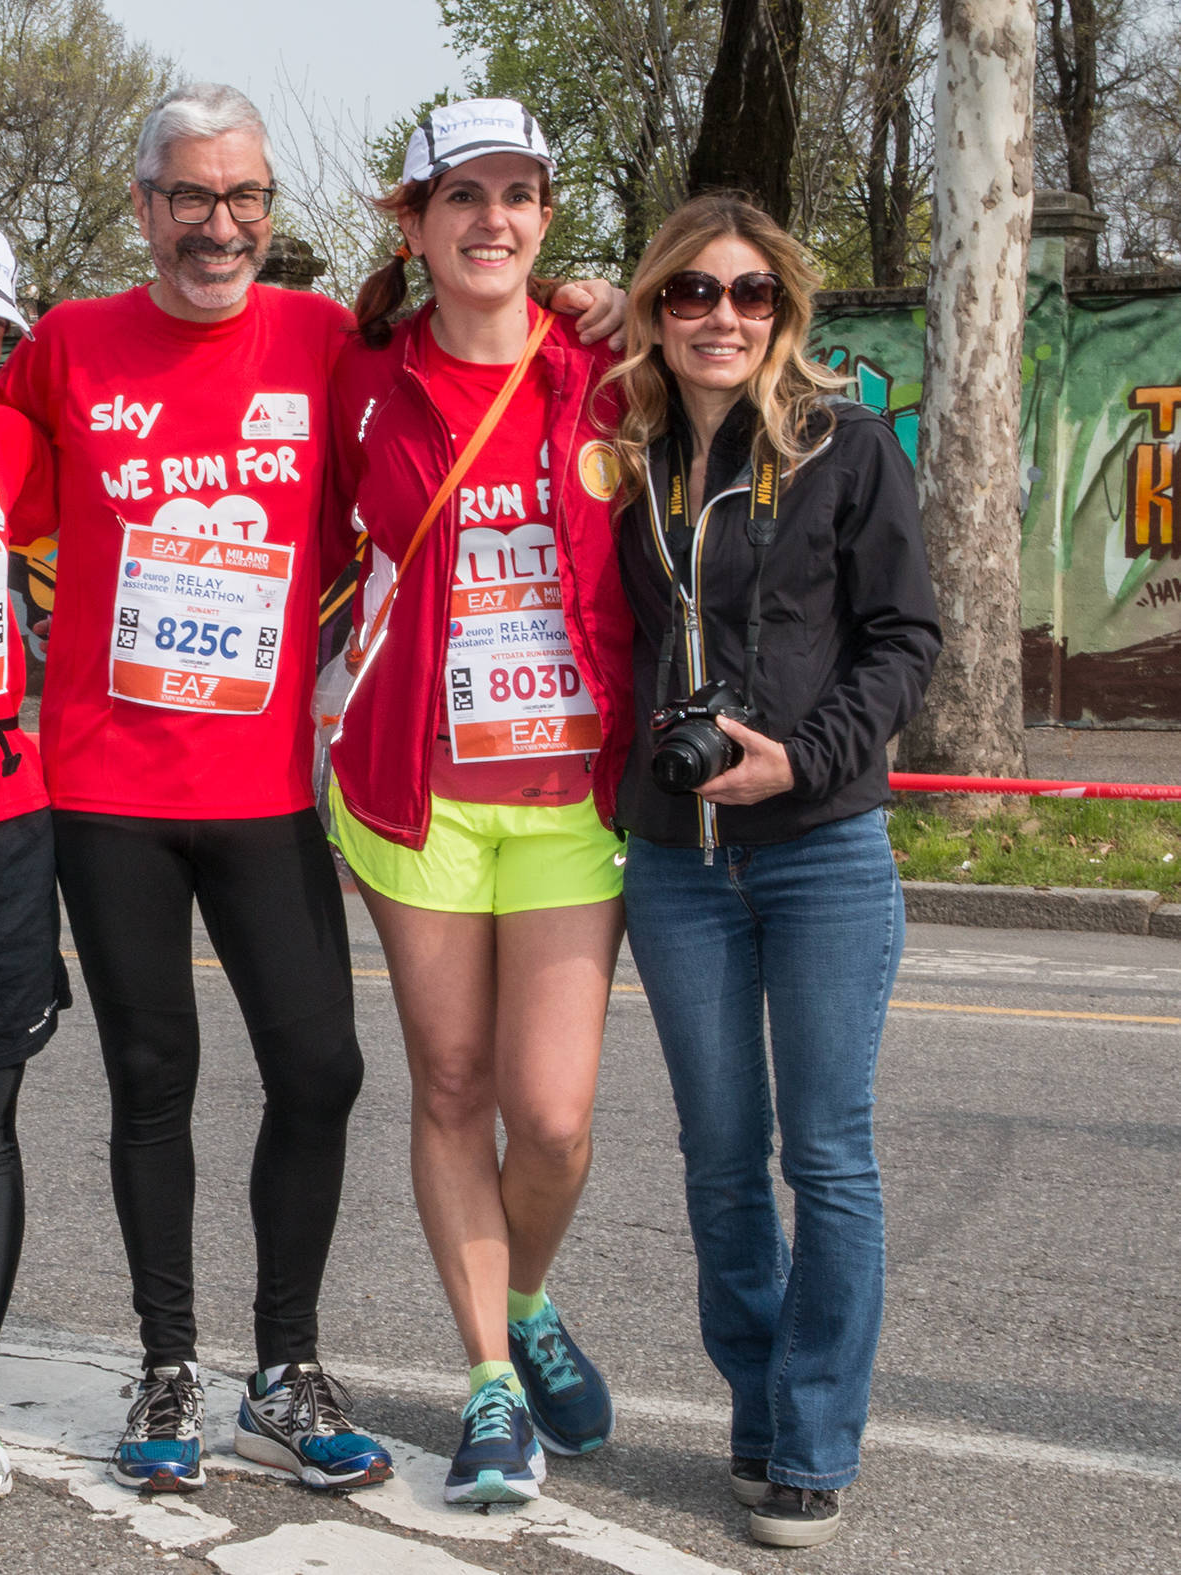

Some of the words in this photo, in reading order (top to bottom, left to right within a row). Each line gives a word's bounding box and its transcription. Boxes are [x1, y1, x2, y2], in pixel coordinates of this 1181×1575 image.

[90, 394, 163, 439] sky
[100, 459, 153, 500] WE
[160, 455, 228, 495] RUN
[236, 445, 301, 486] FOR
[757, 463, 773, 505] Nikon
[460, 483, 526, 525] RUN
[671, 474, 683, 515] Nikon
[151, 538, 191, 557] EA7
[226, 547, 270, 564] MILANO
[468, 544, 555, 583] LILT
[123, 580, 169, 593] assistance
[143, 572, 170, 584] europ
[176, 573, 225, 590] RELAY
[174, 585, 245, 604] MARATHON
[468, 590, 507, 608] EA7
[155, 617, 242, 660] 825C
[466, 627, 494, 638] europ
[500, 619, 548, 633] RELAY
[501, 631, 569, 643] MARATHON
[162, 671, 220, 700] EA7
[490, 664, 581, 703] 803D
[511, 718, 567, 745] EA7
